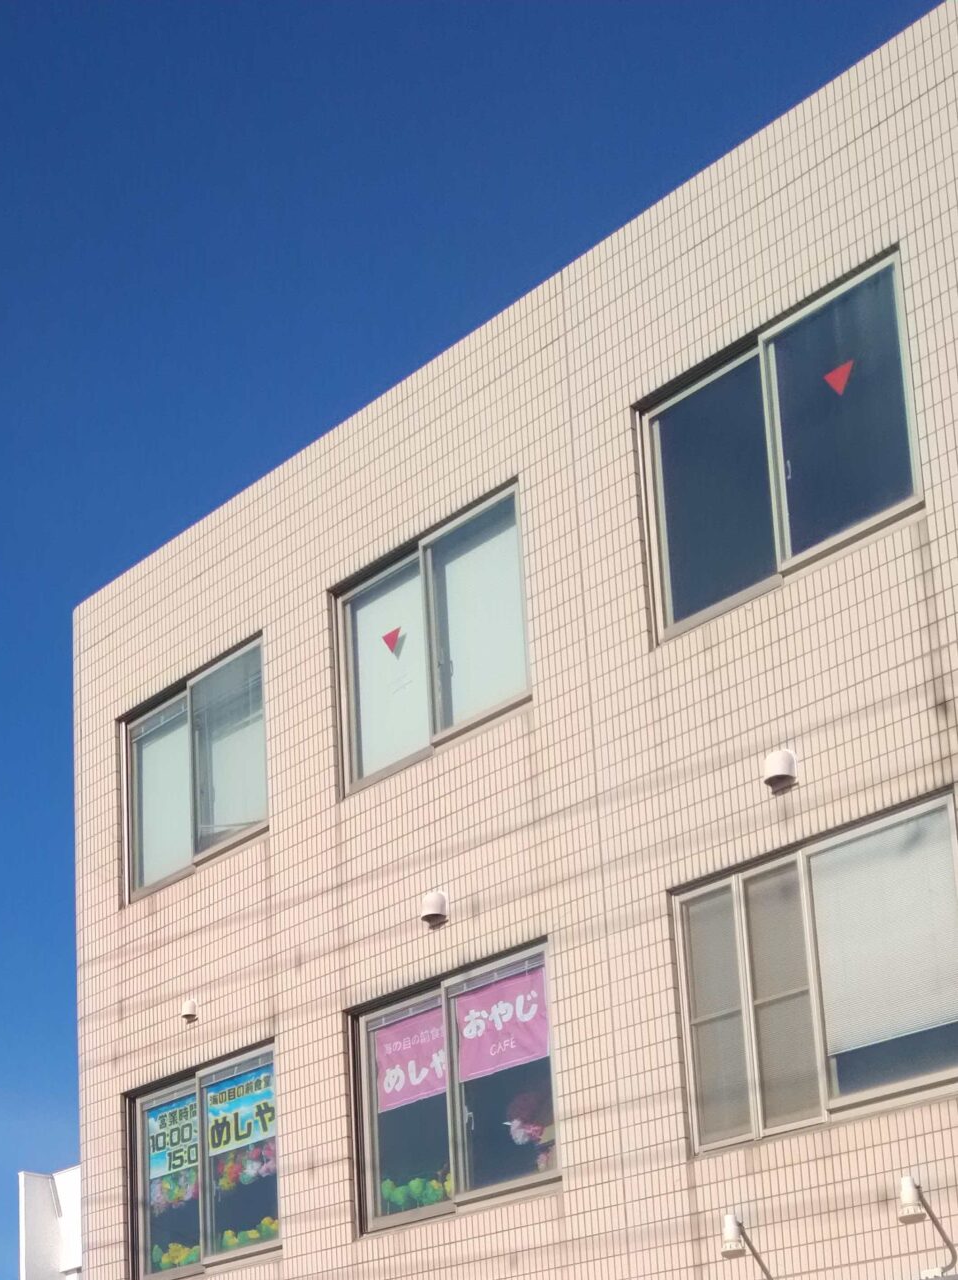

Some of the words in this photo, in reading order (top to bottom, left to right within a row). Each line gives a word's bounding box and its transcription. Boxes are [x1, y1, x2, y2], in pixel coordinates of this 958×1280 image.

[463, 990, 538, 1039] おやじ
[384, 1026, 444, 1055] 海の目の前食
[383, 1049, 446, 1094] めしや
[210, 1102, 275, 1149] めしや
